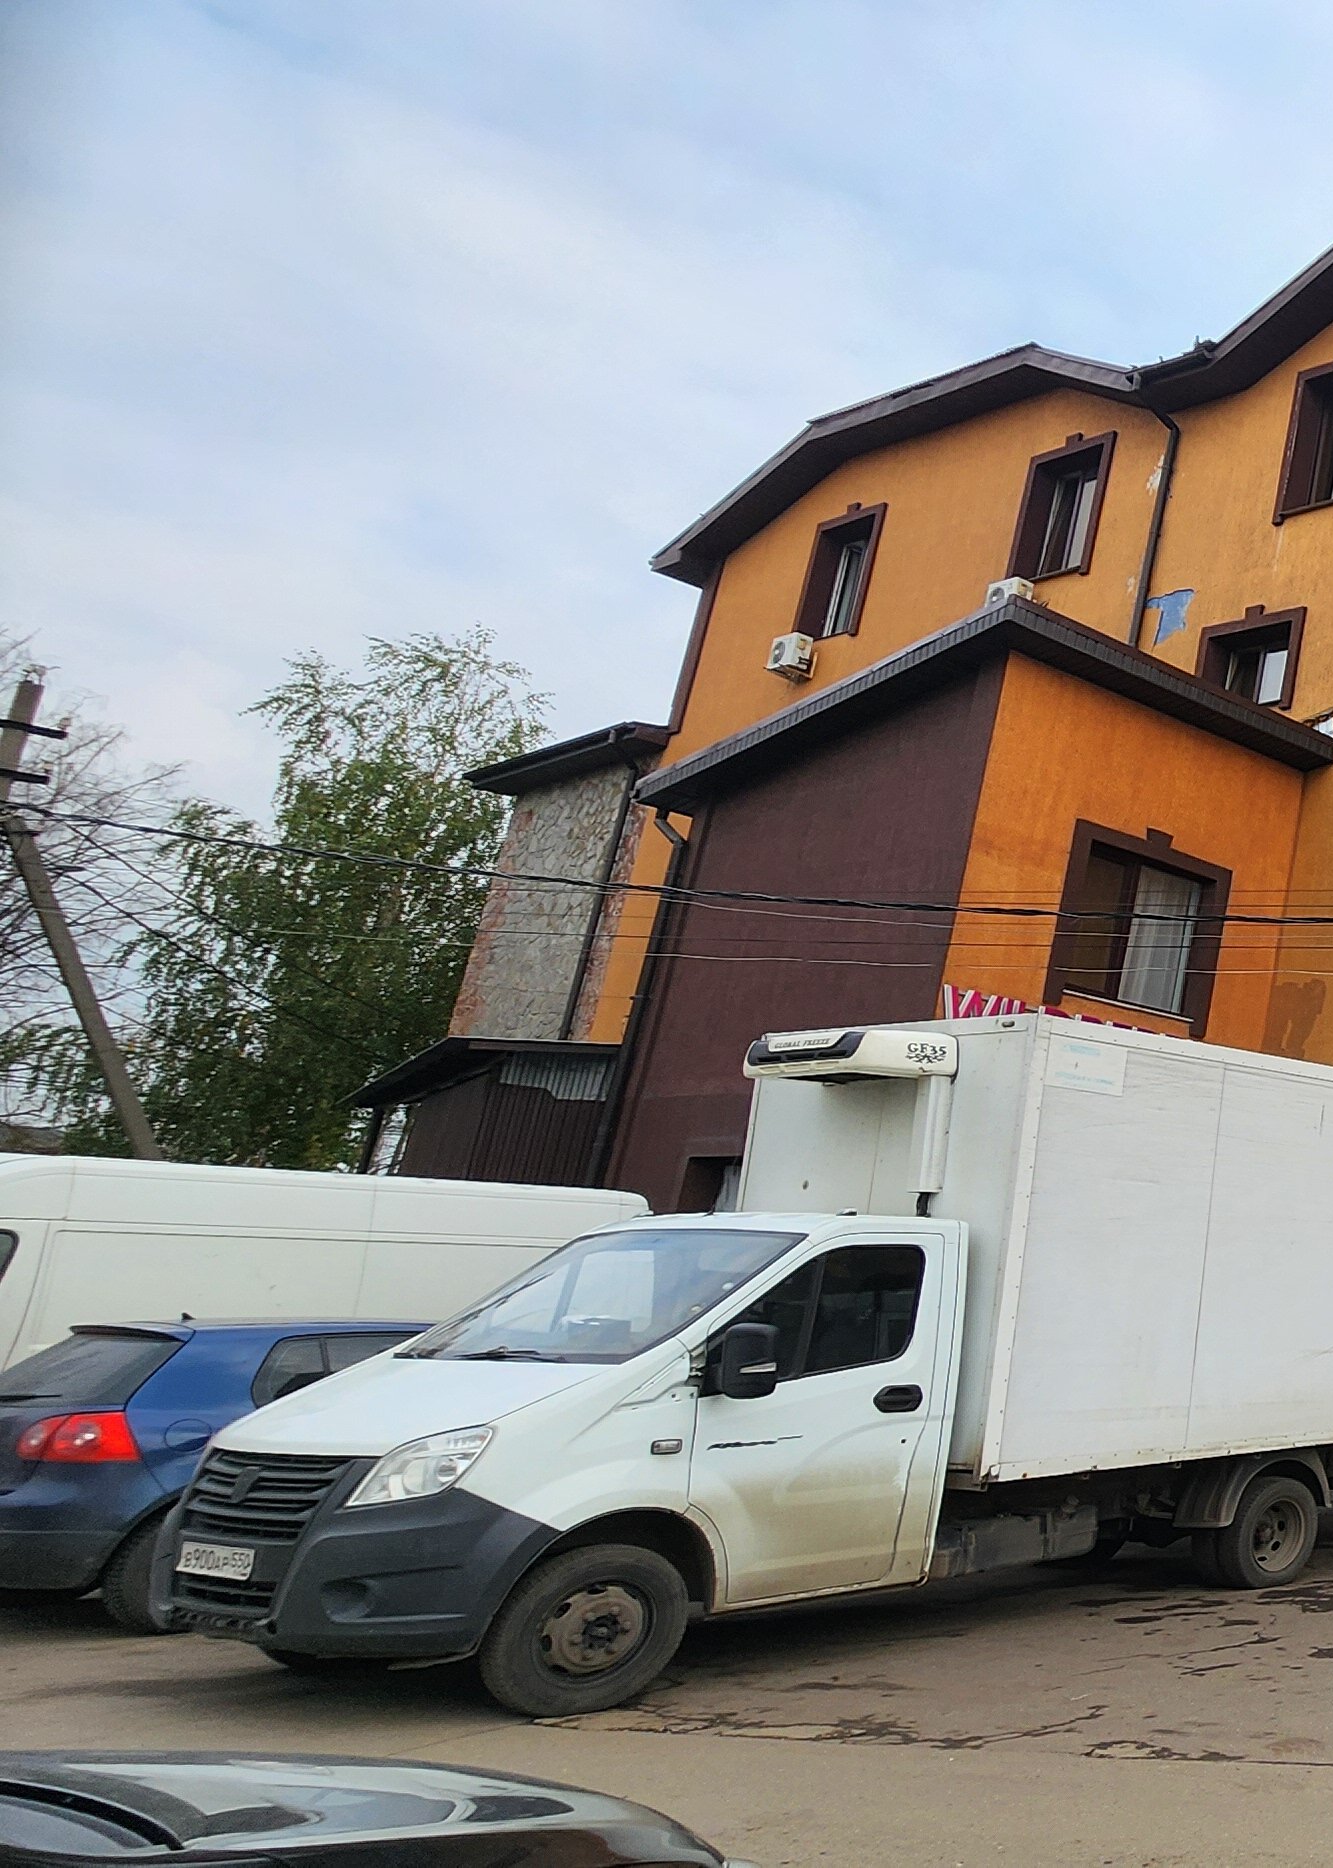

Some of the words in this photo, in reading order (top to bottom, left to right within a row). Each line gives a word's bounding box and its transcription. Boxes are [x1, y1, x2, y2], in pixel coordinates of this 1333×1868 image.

[775, 1041, 801, 1049] GLOBAL
[803, 1038, 831, 1047] FREEZE
[907, 1042, 947, 1056] GF35
